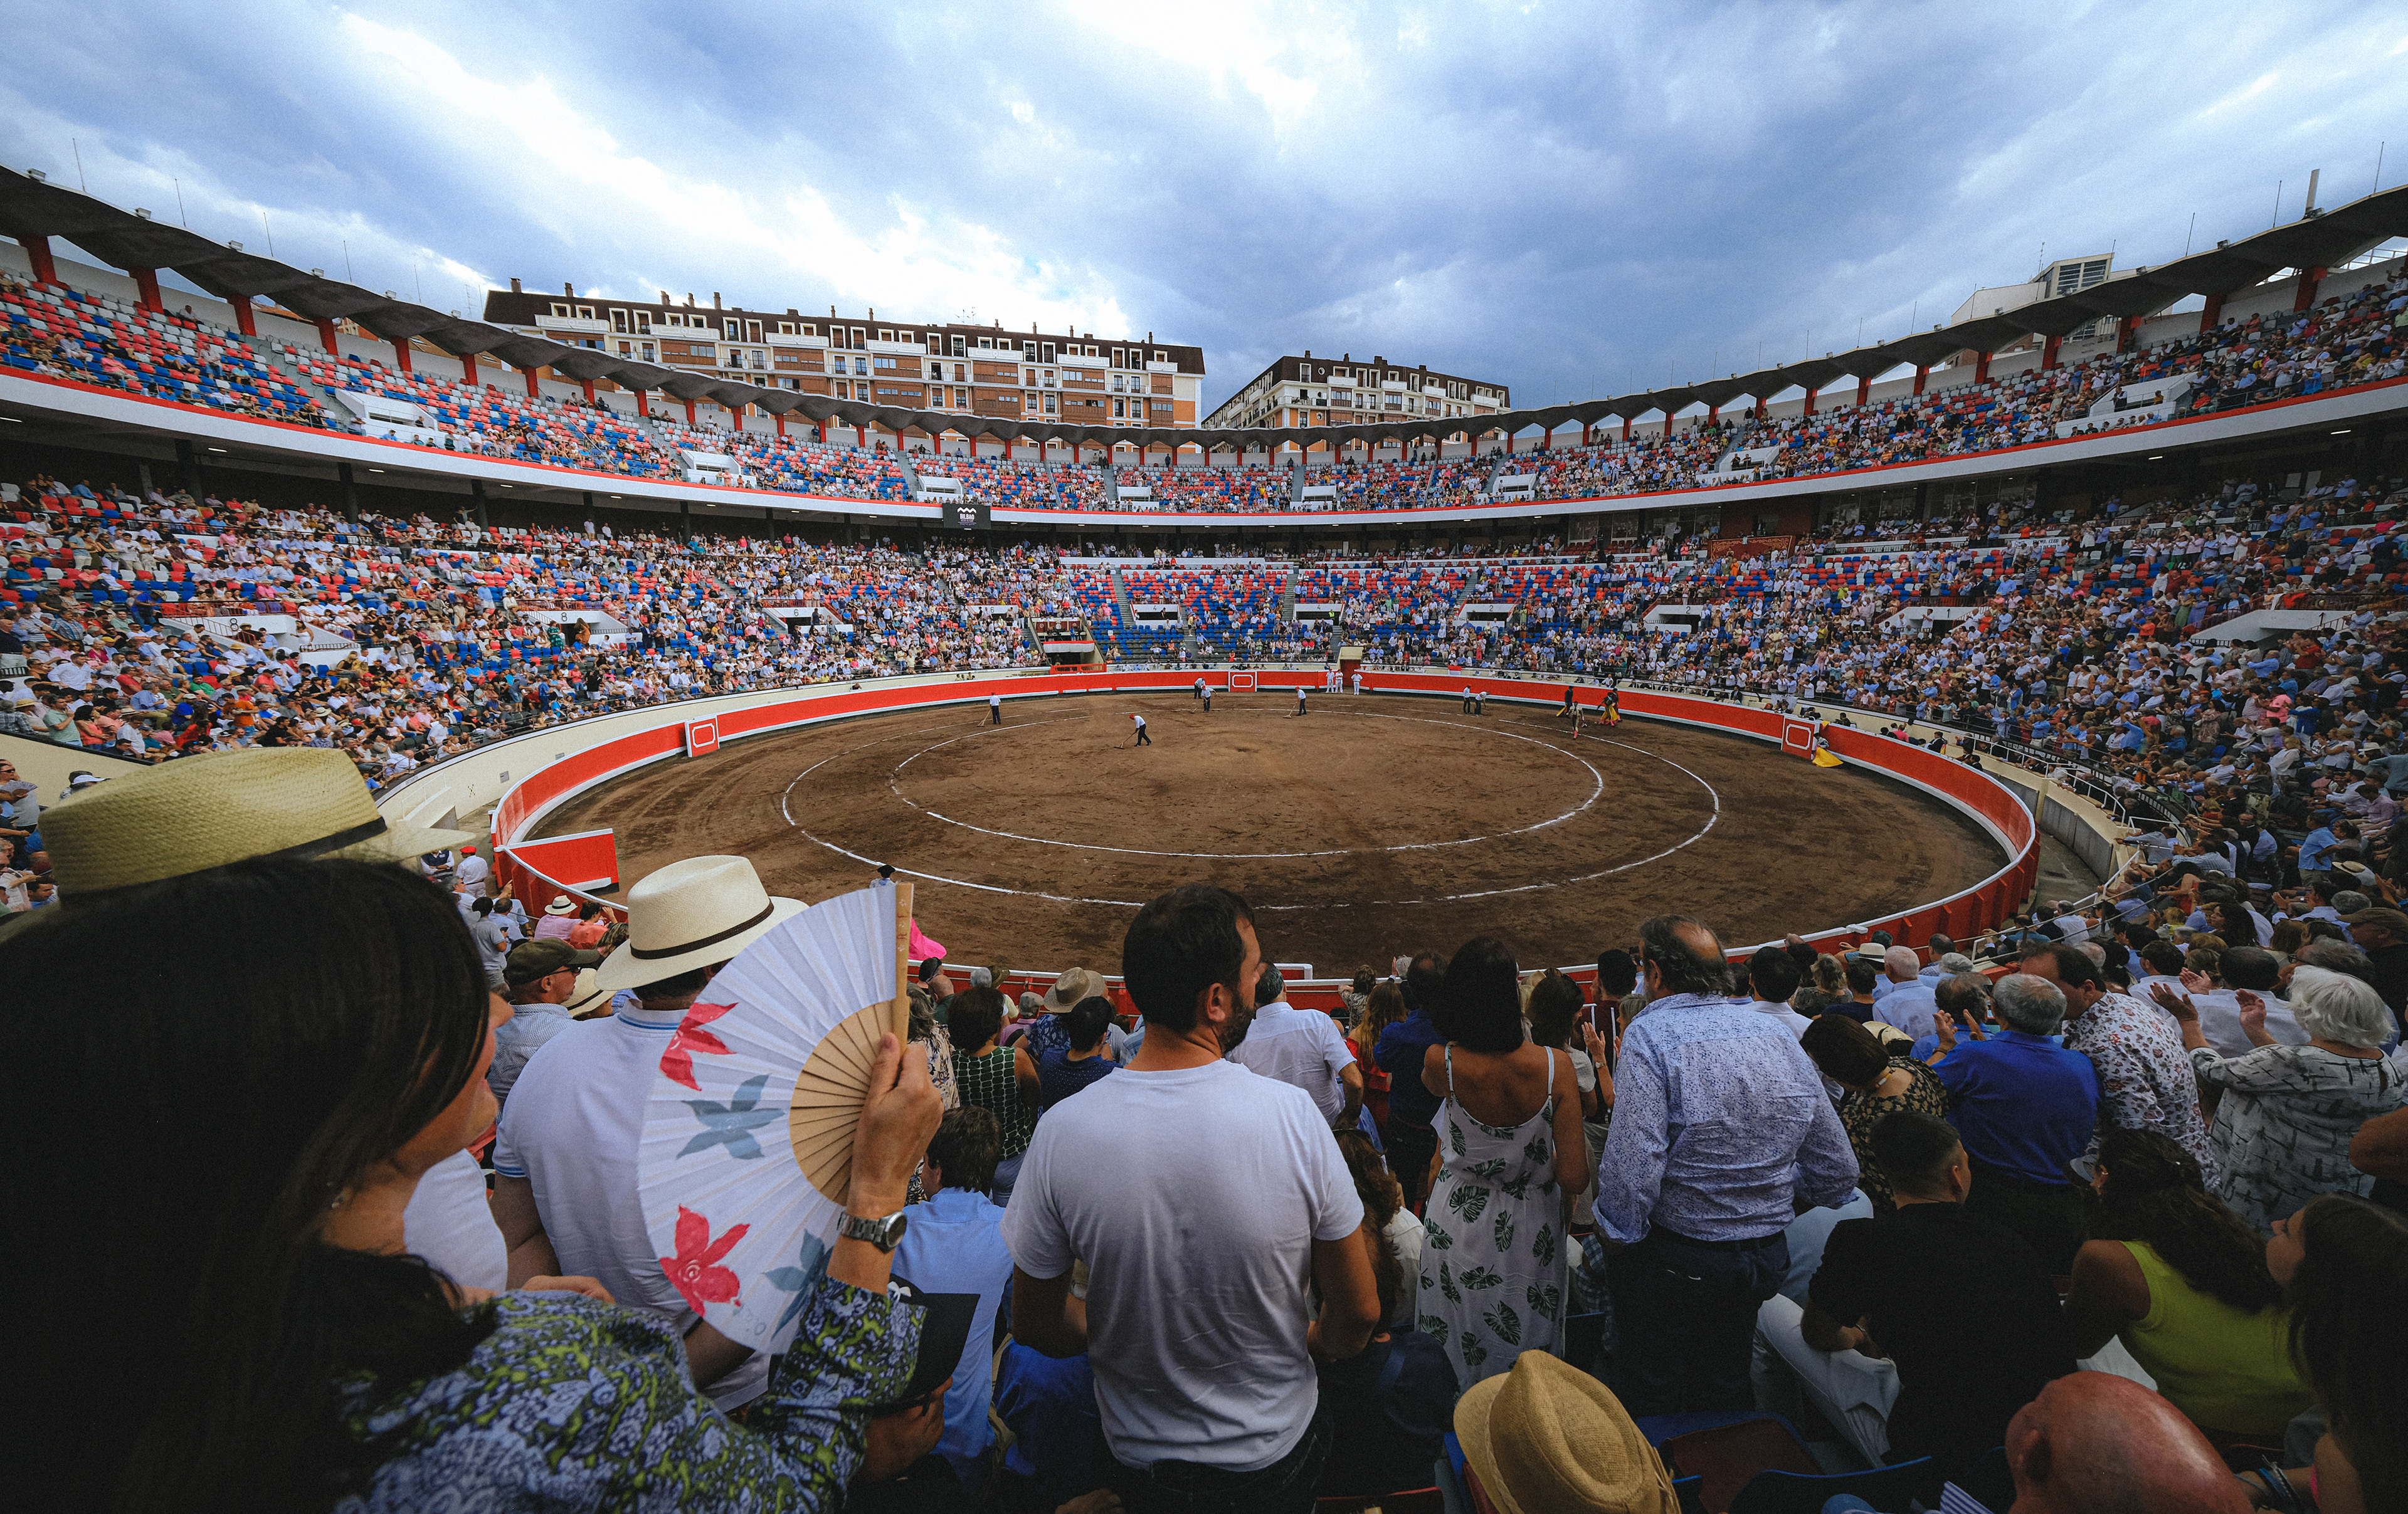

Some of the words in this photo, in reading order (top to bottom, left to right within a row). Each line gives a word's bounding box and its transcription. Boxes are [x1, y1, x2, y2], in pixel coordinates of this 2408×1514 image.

[794, 608, 799, 617] 6
[1686, 606, 1691, 614] 2
[1946, 608, 1950, 618] 1
[561, 612, 568, 622] 8
[230, 618, 239, 631] 8
